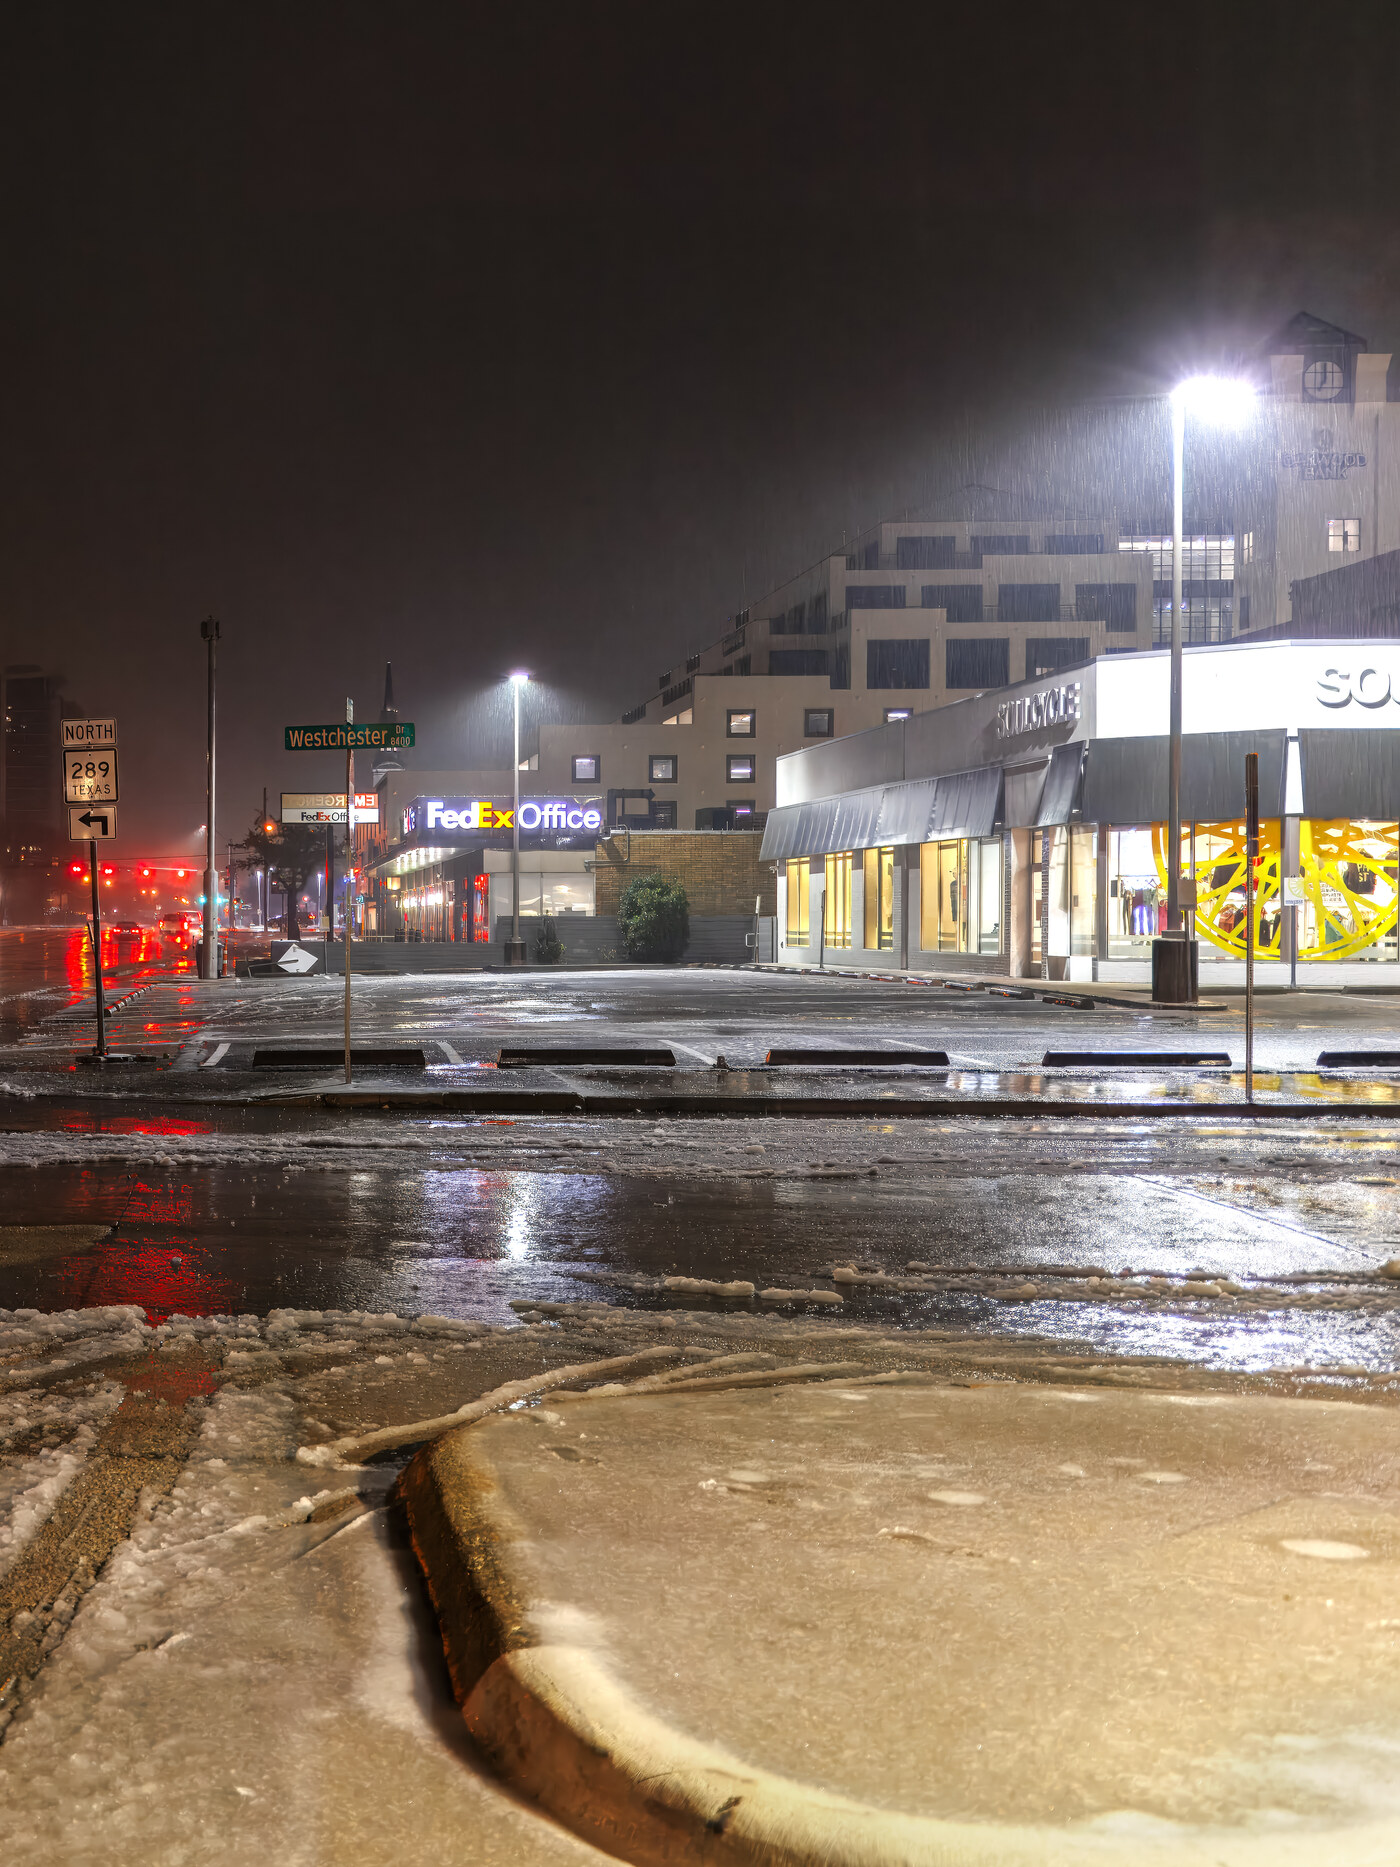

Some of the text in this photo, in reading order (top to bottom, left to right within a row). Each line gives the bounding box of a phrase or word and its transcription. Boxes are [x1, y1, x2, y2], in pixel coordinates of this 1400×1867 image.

[1303, 467, 1347, 480] BANK
[1315, 666, 1400, 709] SO
[997, 683, 1081, 738] SOULCYCLE
[65, 724, 113, 740] NORTH
[289, 725, 405, 748] Westchester Dr
[390, 736, 411, 746] 8400
[71, 761, 110, 779] 289
[72, 784, 111, 796] TEXAS
[301, 811, 360, 822] FedEx Offe
[427, 801, 514, 829] FedEx
[518, 802, 601, 829] Office
